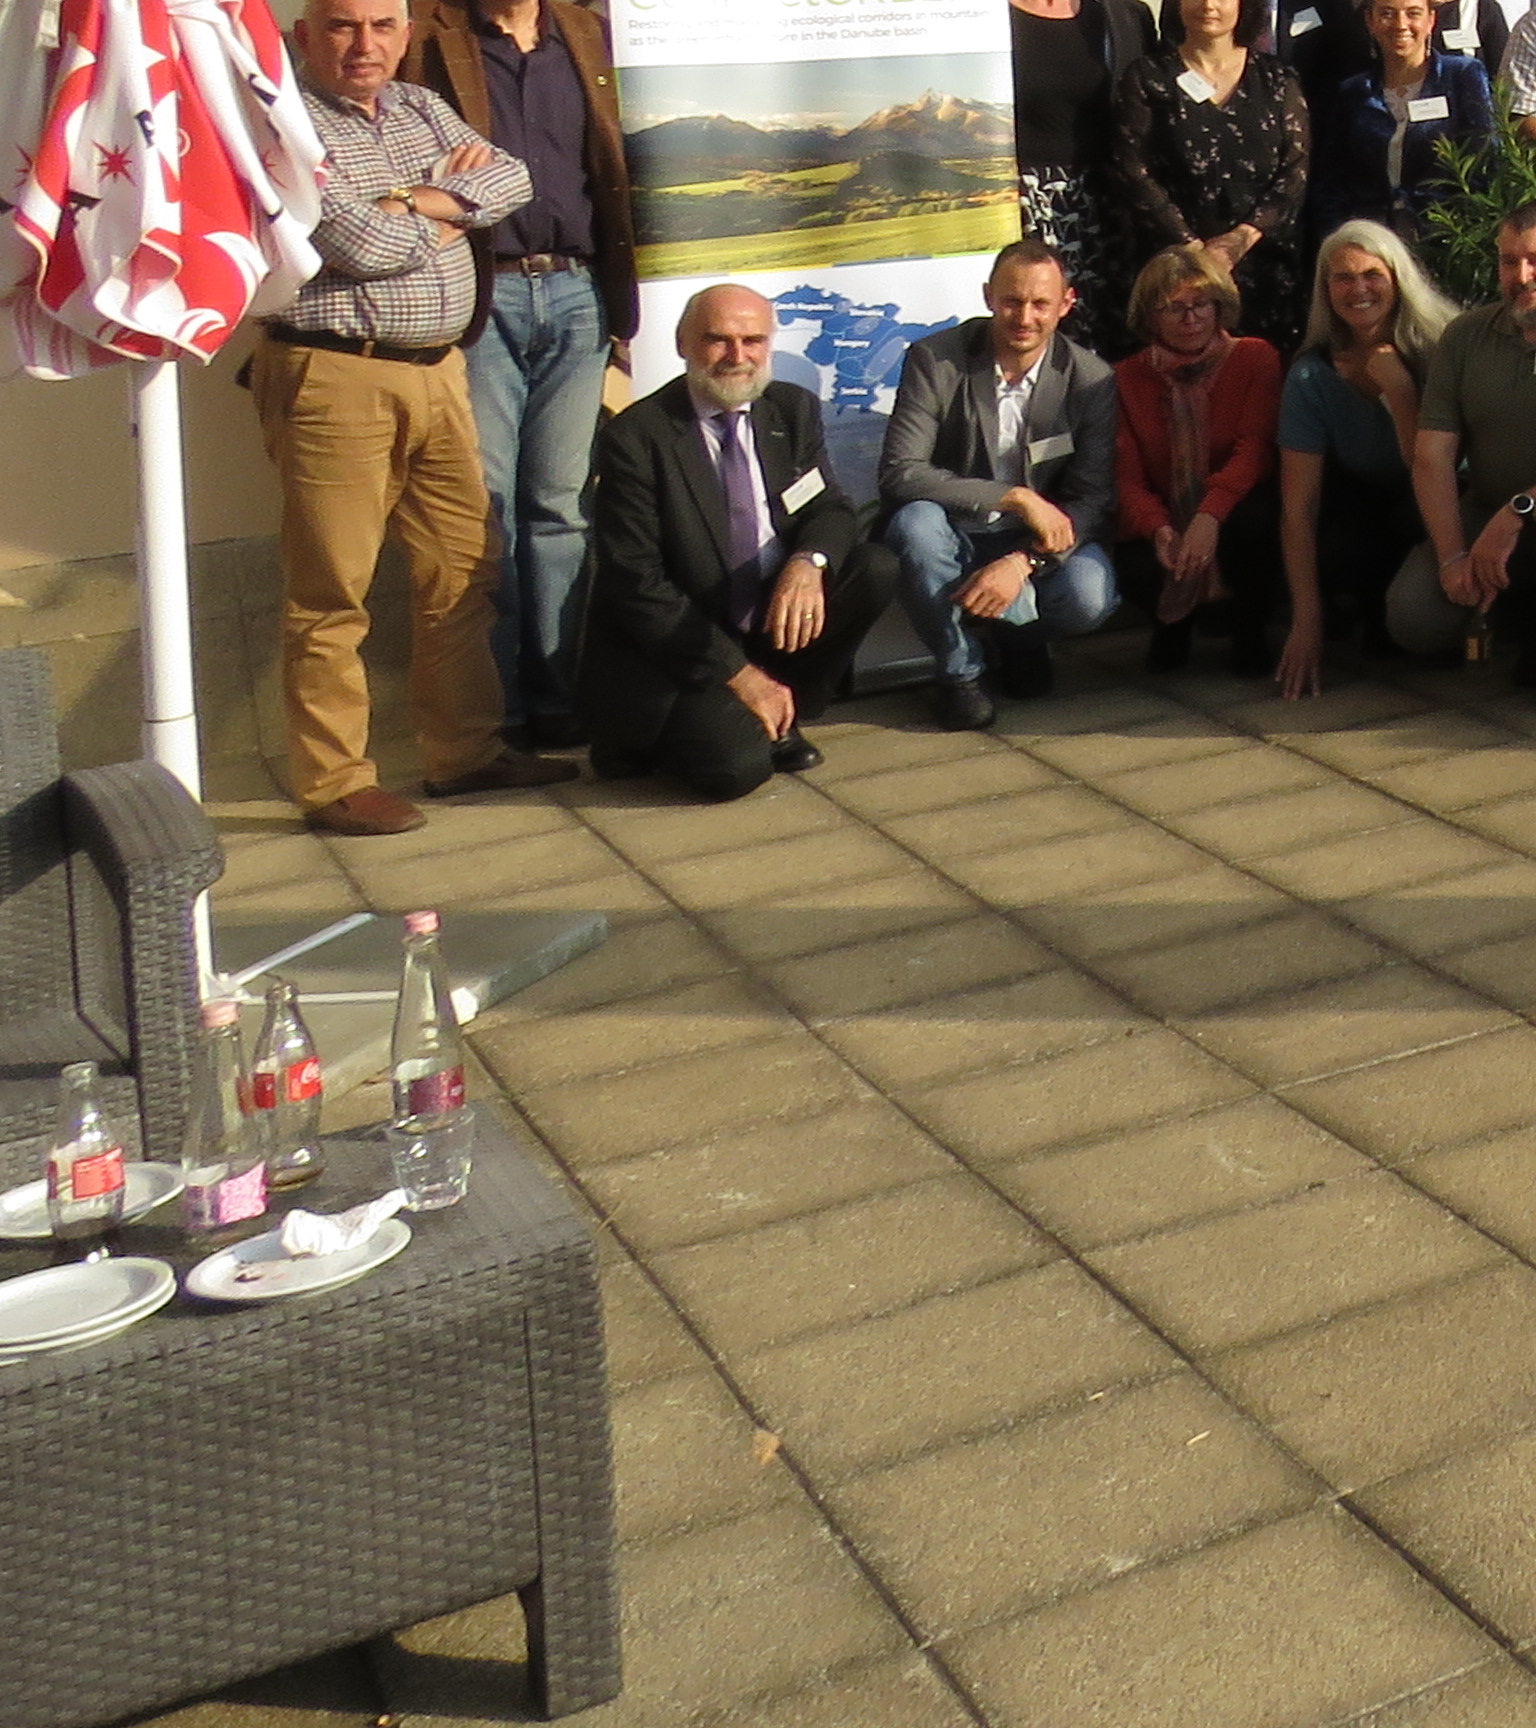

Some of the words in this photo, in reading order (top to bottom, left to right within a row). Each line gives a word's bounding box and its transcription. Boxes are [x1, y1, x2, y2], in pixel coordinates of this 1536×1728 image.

[790, 12, 856, 29] ecological
[856, 10, 912, 24] corridors
[800, 29, 814, 41] in
[815, 28, 838, 40] the
[840, 26, 892, 40] Danube
[894, 25, 928, 37] basin
